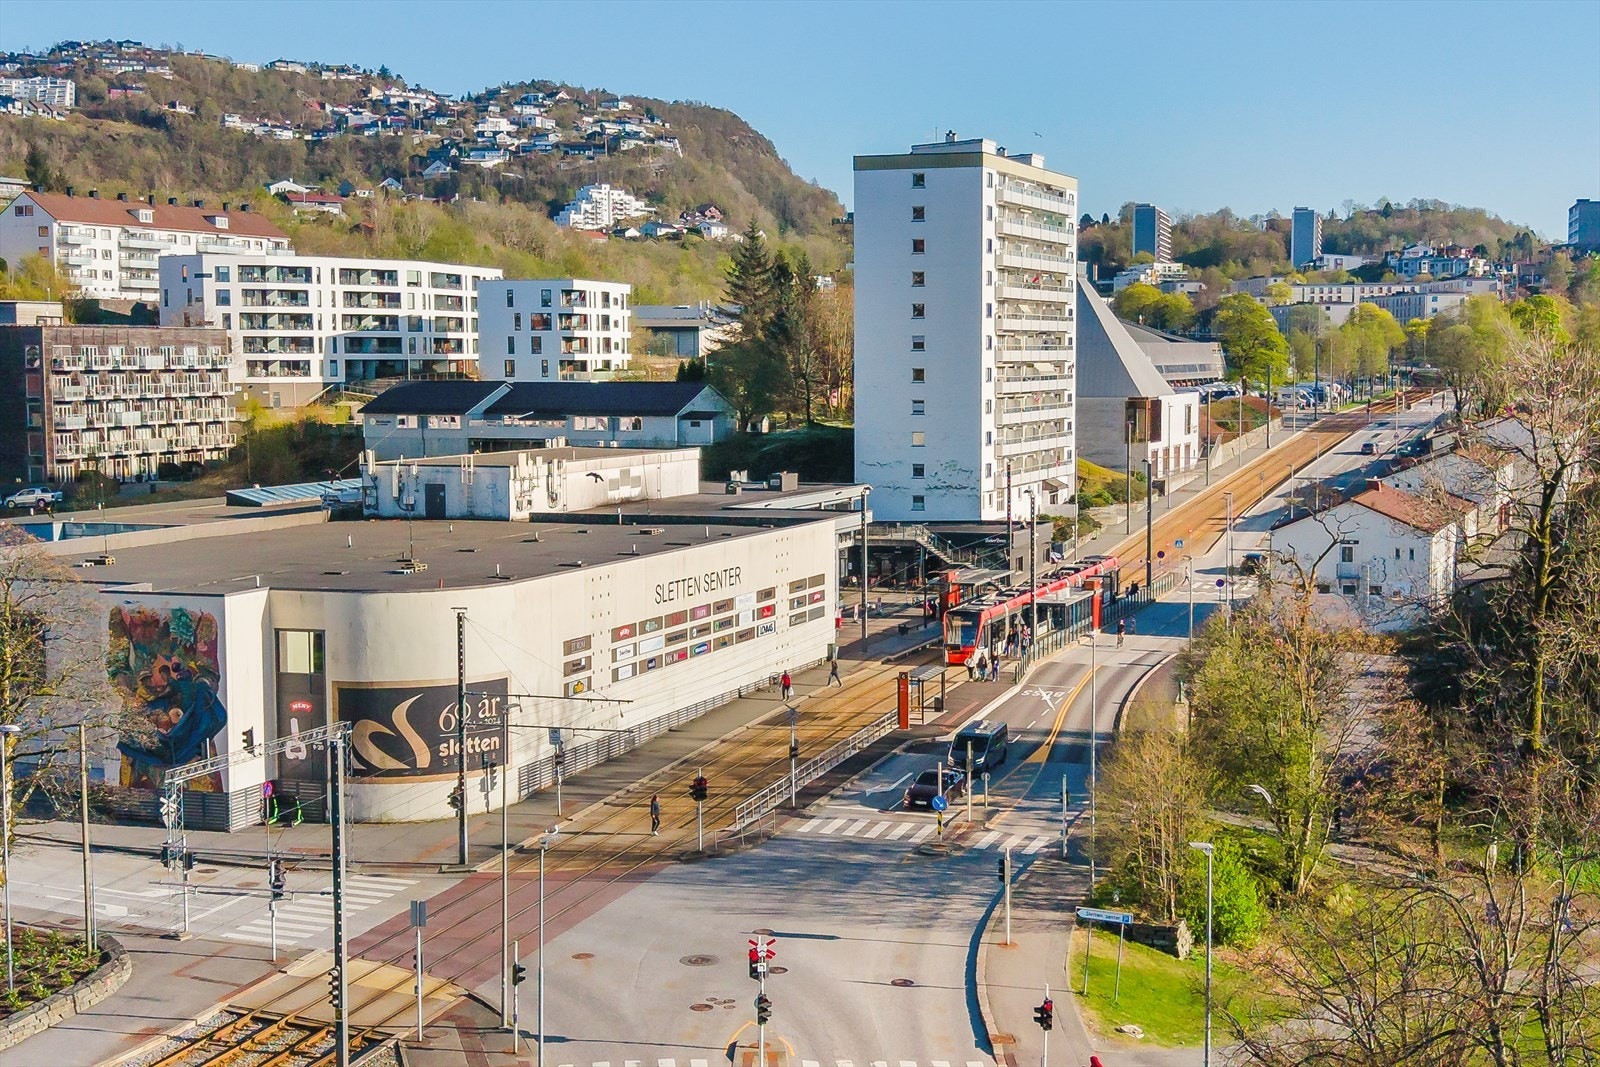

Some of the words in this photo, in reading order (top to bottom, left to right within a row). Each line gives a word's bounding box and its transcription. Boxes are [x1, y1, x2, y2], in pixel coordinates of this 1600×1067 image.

[655, 574, 701, 605] SLETTEN
[703, 566, 742, 593] SENTER
[292, 702, 311, 710] MENY
[1021, 689, 1066, 700] BUSS
[439, 701, 472, 732] 60
[478, 691, 501, 718] år
